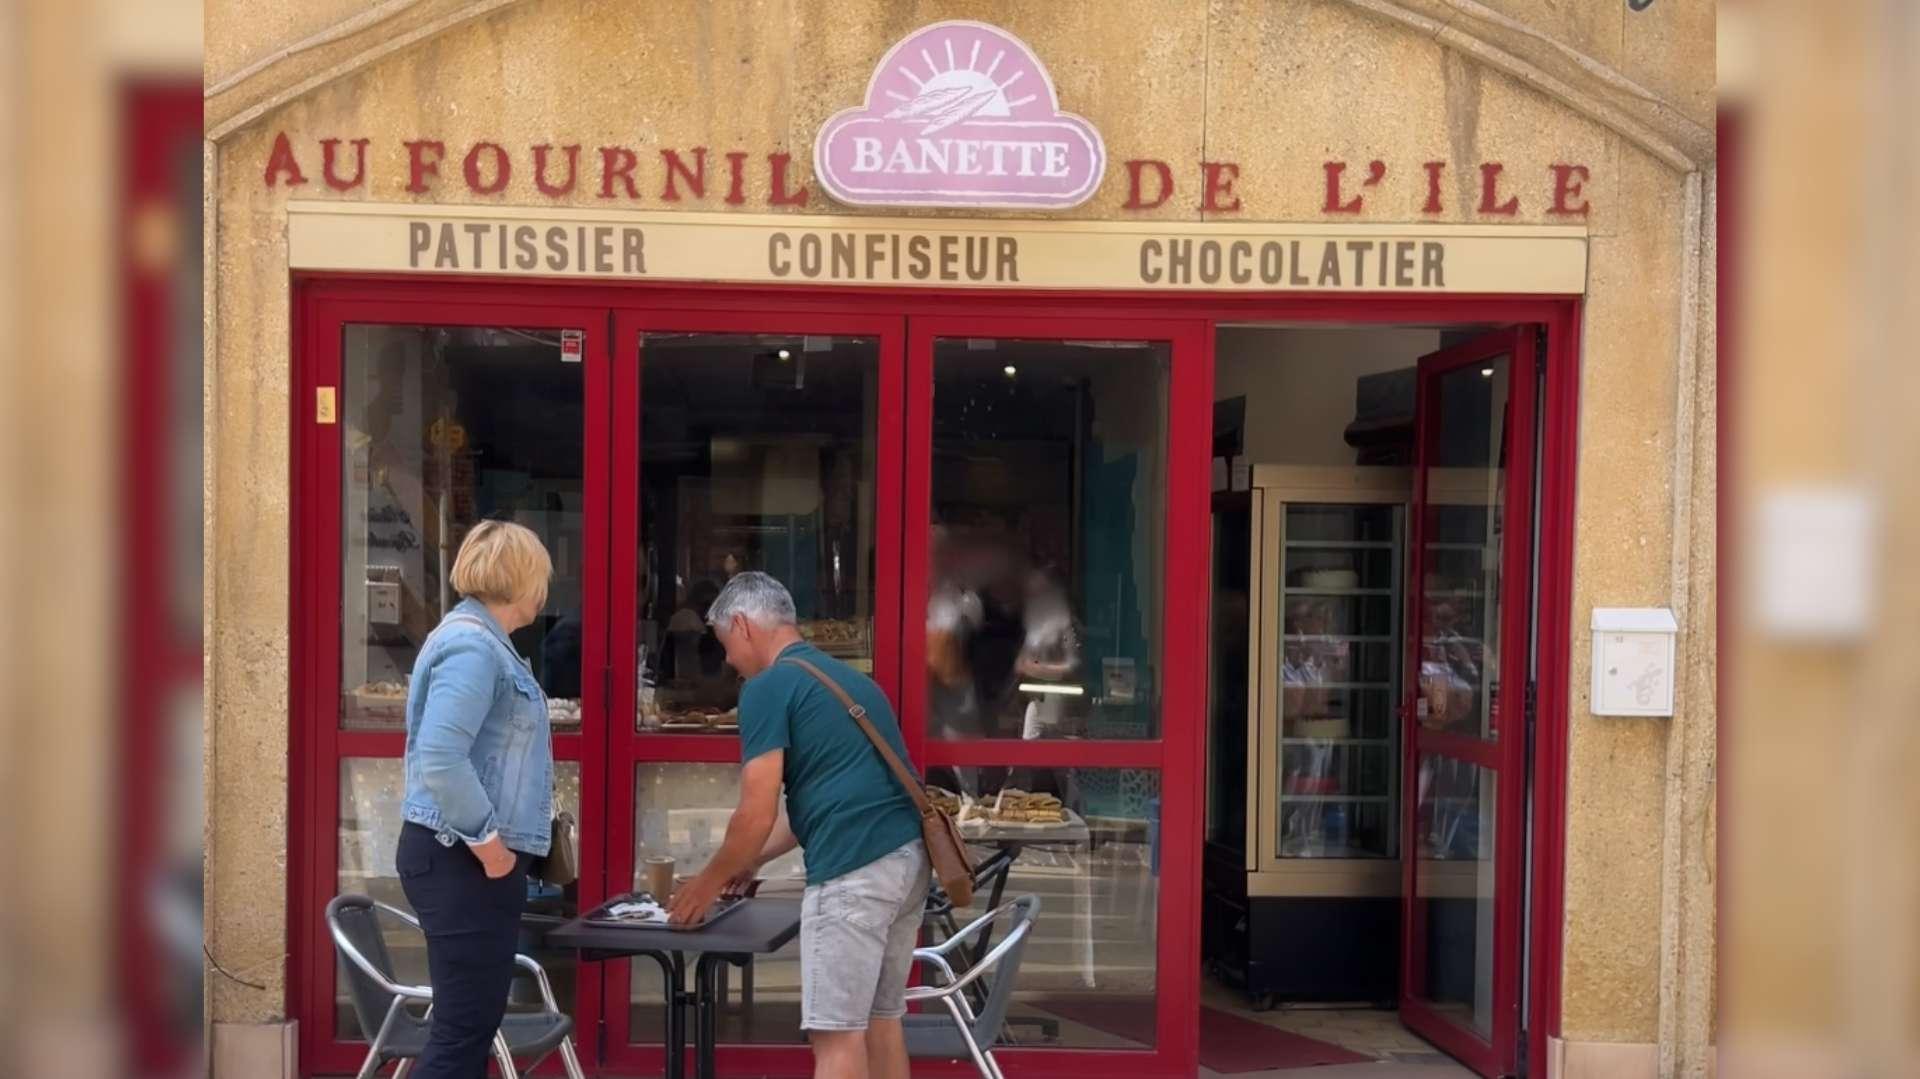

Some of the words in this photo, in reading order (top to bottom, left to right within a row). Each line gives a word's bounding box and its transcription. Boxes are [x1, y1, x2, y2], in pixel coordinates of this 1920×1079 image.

[263, 130, 371, 191] AU
[402, 139, 809, 207] FOURNIL
[1121, 159, 1240, 213] DE
[850, 137, 1071, 178] BANETTE
[408, 221, 648, 274] PATISSIER
[767, 231, 1020, 282] CONFISEUR
[1139, 238, 1446, 288] CHOCOLATIER
